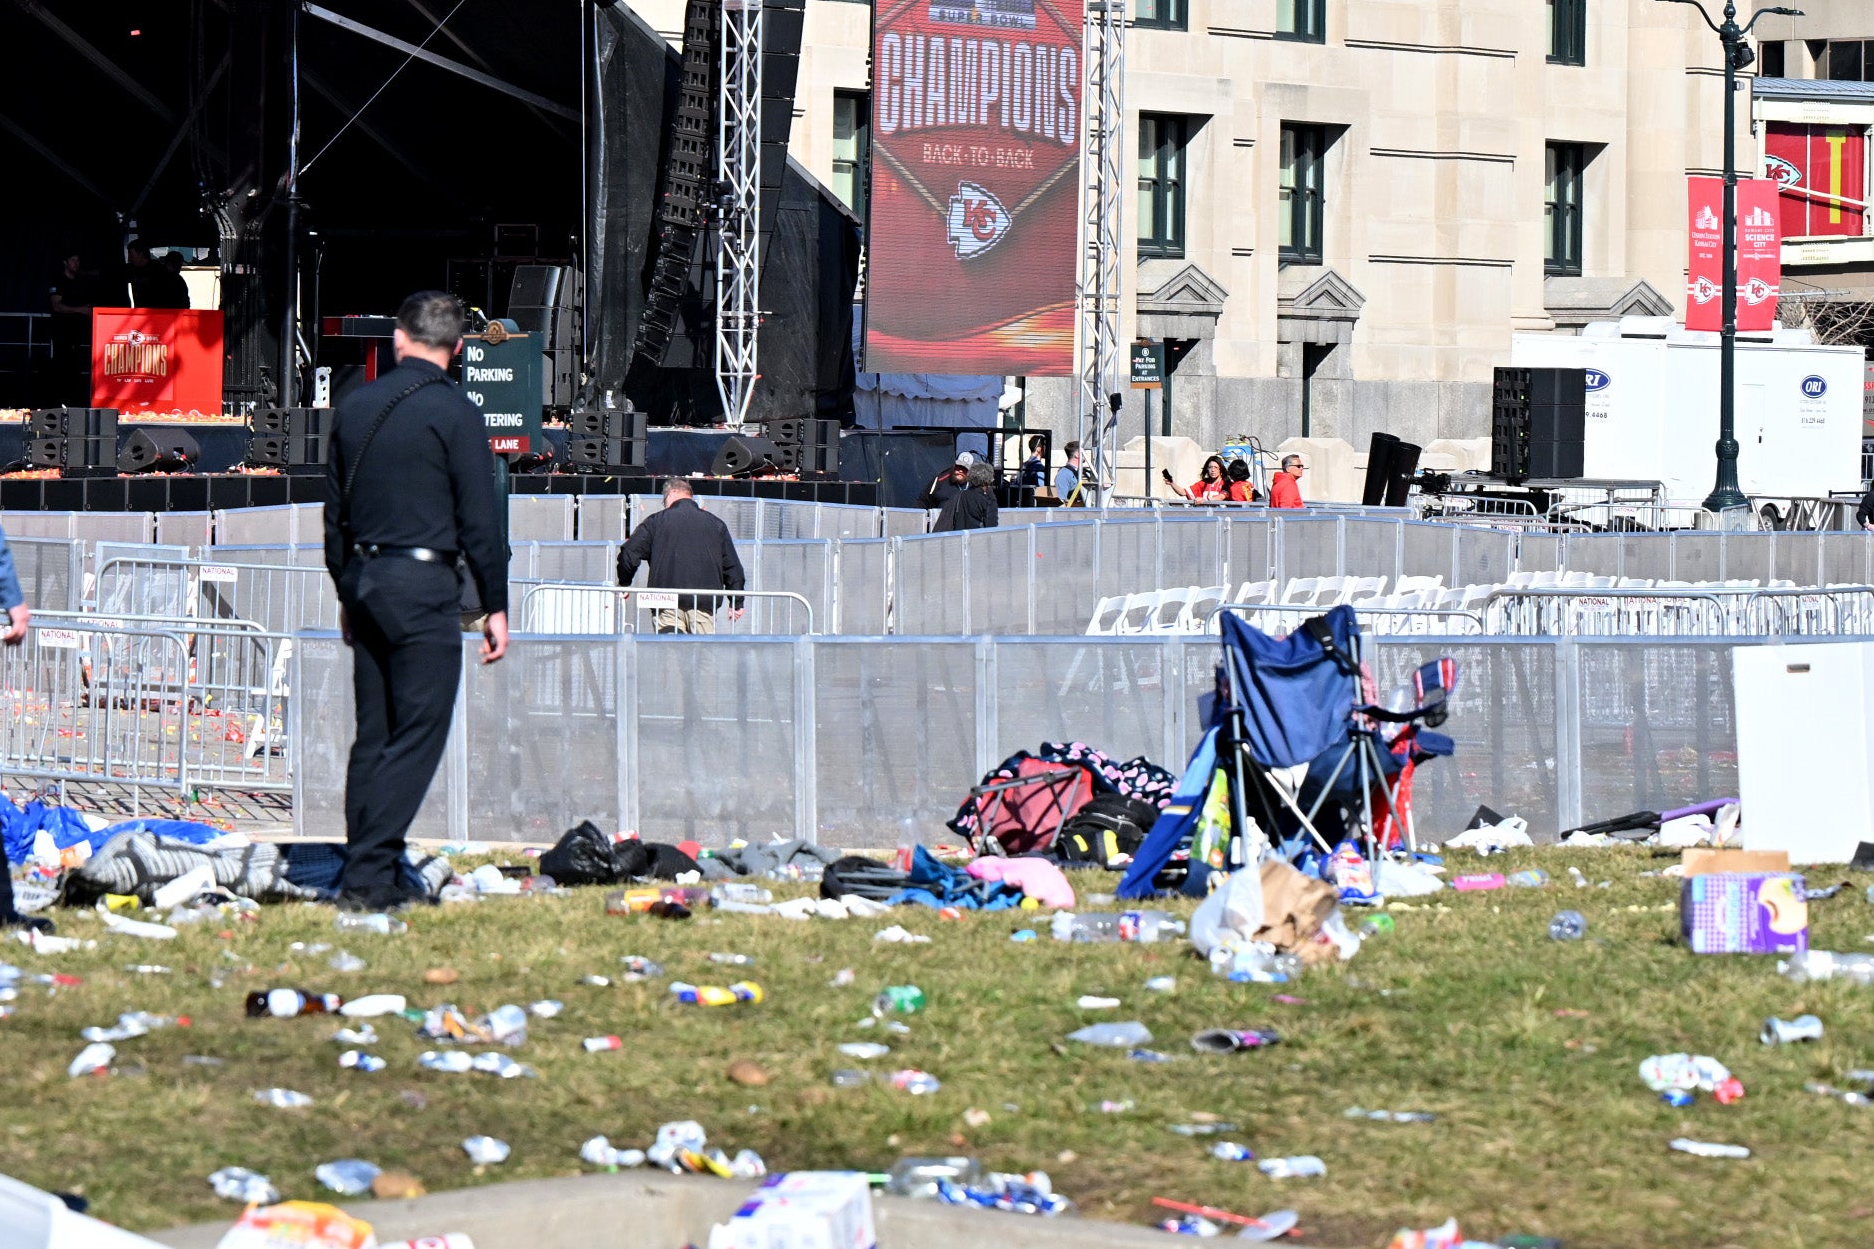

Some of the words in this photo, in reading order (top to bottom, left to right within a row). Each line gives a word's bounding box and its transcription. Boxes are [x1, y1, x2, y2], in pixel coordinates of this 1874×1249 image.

[879, 32, 1077, 145] CHAMPIONS
[1745, 233, 1775, 242] SCIENCE
[105, 344, 167, 376] CHAMPIONS
[467, 367, 513, 381] PARKING
[1586, 374, 1601, 386] RI
[1806, 381, 1823, 393] ORI
[484, 414, 523, 426] TERING
[495, 439, 519, 449] LANE
[203, 567, 235, 575] NATIONAL
[41, 631, 75, 640] NATIONAL
